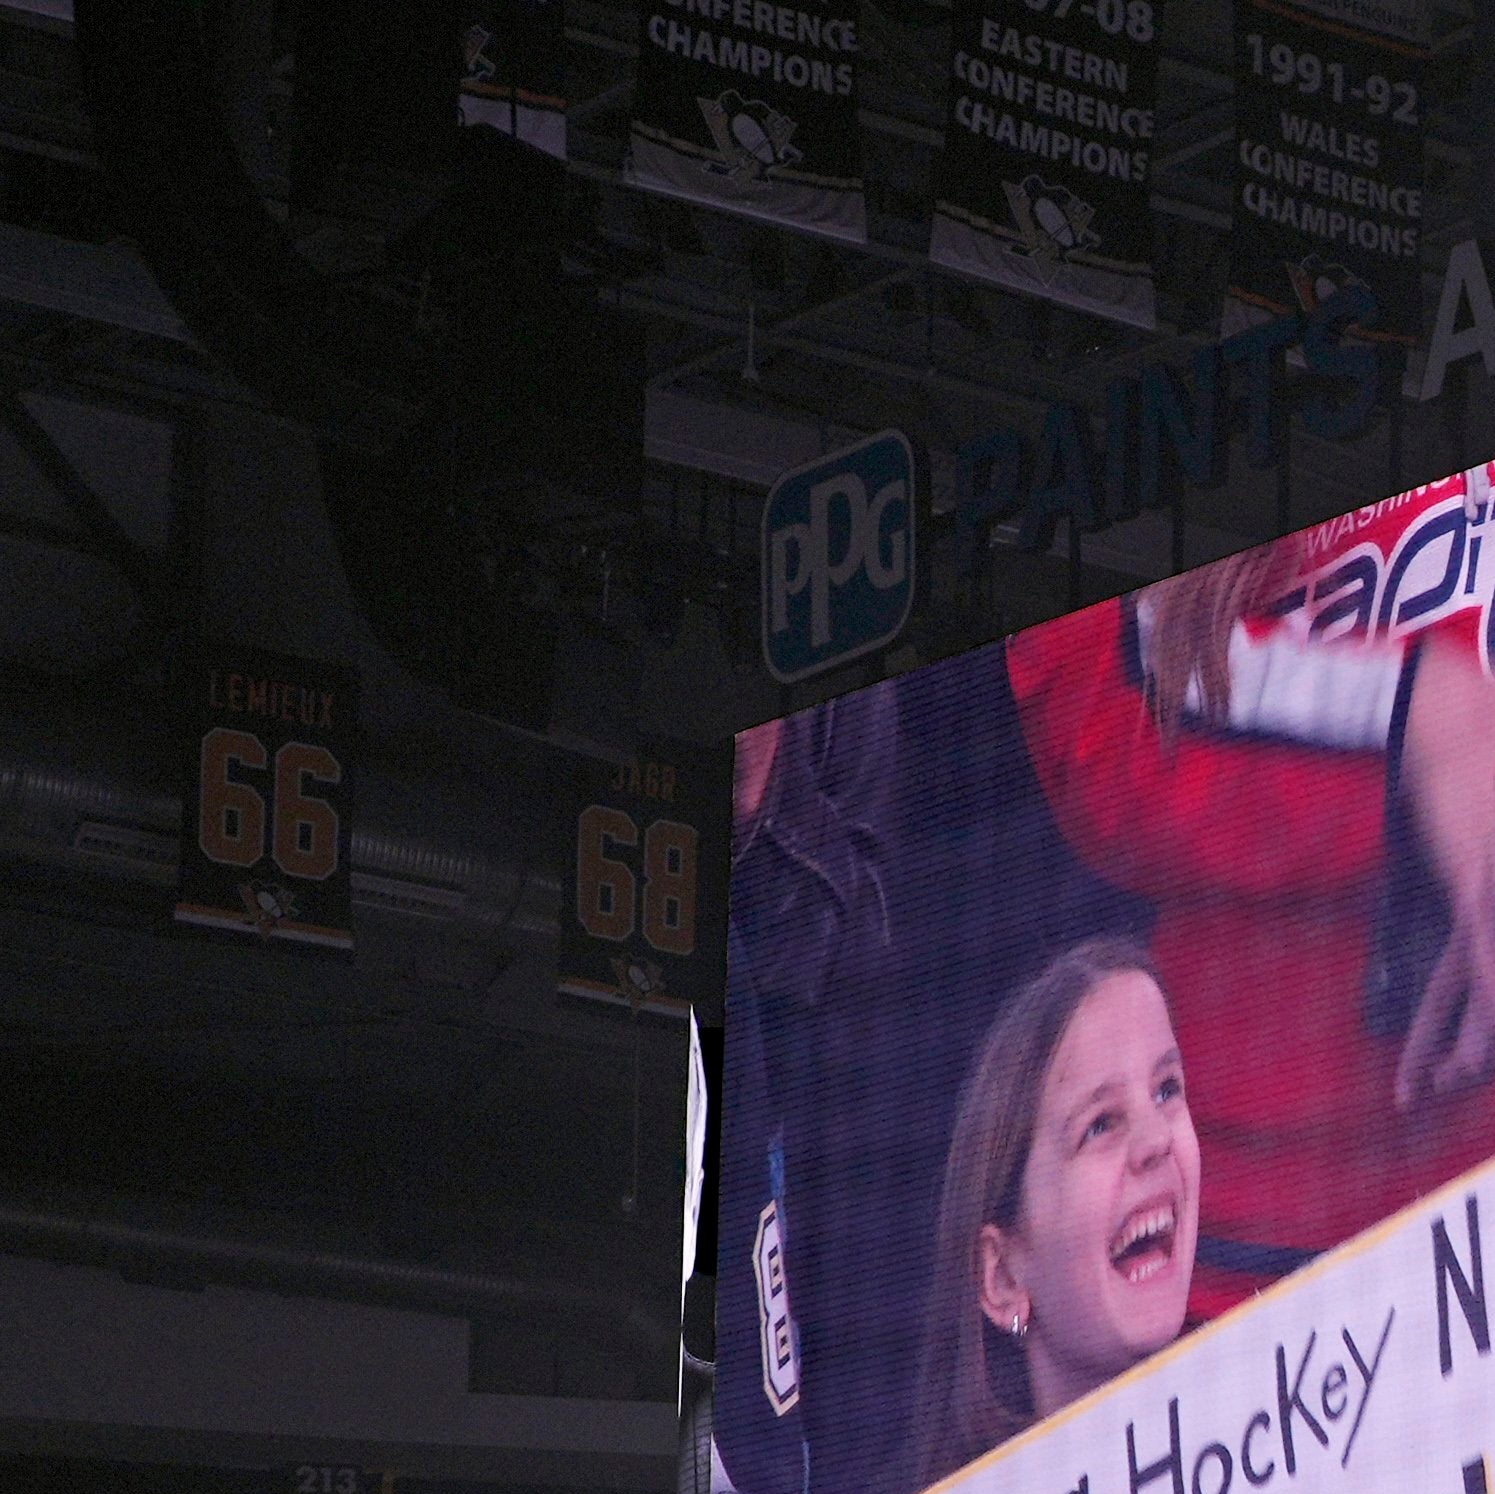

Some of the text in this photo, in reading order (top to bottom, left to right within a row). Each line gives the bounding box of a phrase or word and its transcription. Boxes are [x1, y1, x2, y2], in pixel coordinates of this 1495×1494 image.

[647, 14, 854, 97] CHAMPIONS
[664, 0, 858, 53] NFERENCE
[980, 17, 1129, 94] EASTERN
[953, 49, 1156, 141] CONFERENCE
[1246, 34, 1420, 125] 1991-92
[954, 95, 1150, 184] CHAMPIONS
[1240, 139, 1422, 219] CONFERENCE
[1280, 111, 1381, 169] WALES
[1242, 182, 1418, 260] CHAMPIONS
[771, 472, 909, 648] PPG
[957, 284, 1383, 580] PAINTS
[208, 671, 336, 729] LEMIEUX
[199, 727, 342, 882] 66
[611, 762, 677, 802] JAGR
[577, 804, 698, 957] 68
